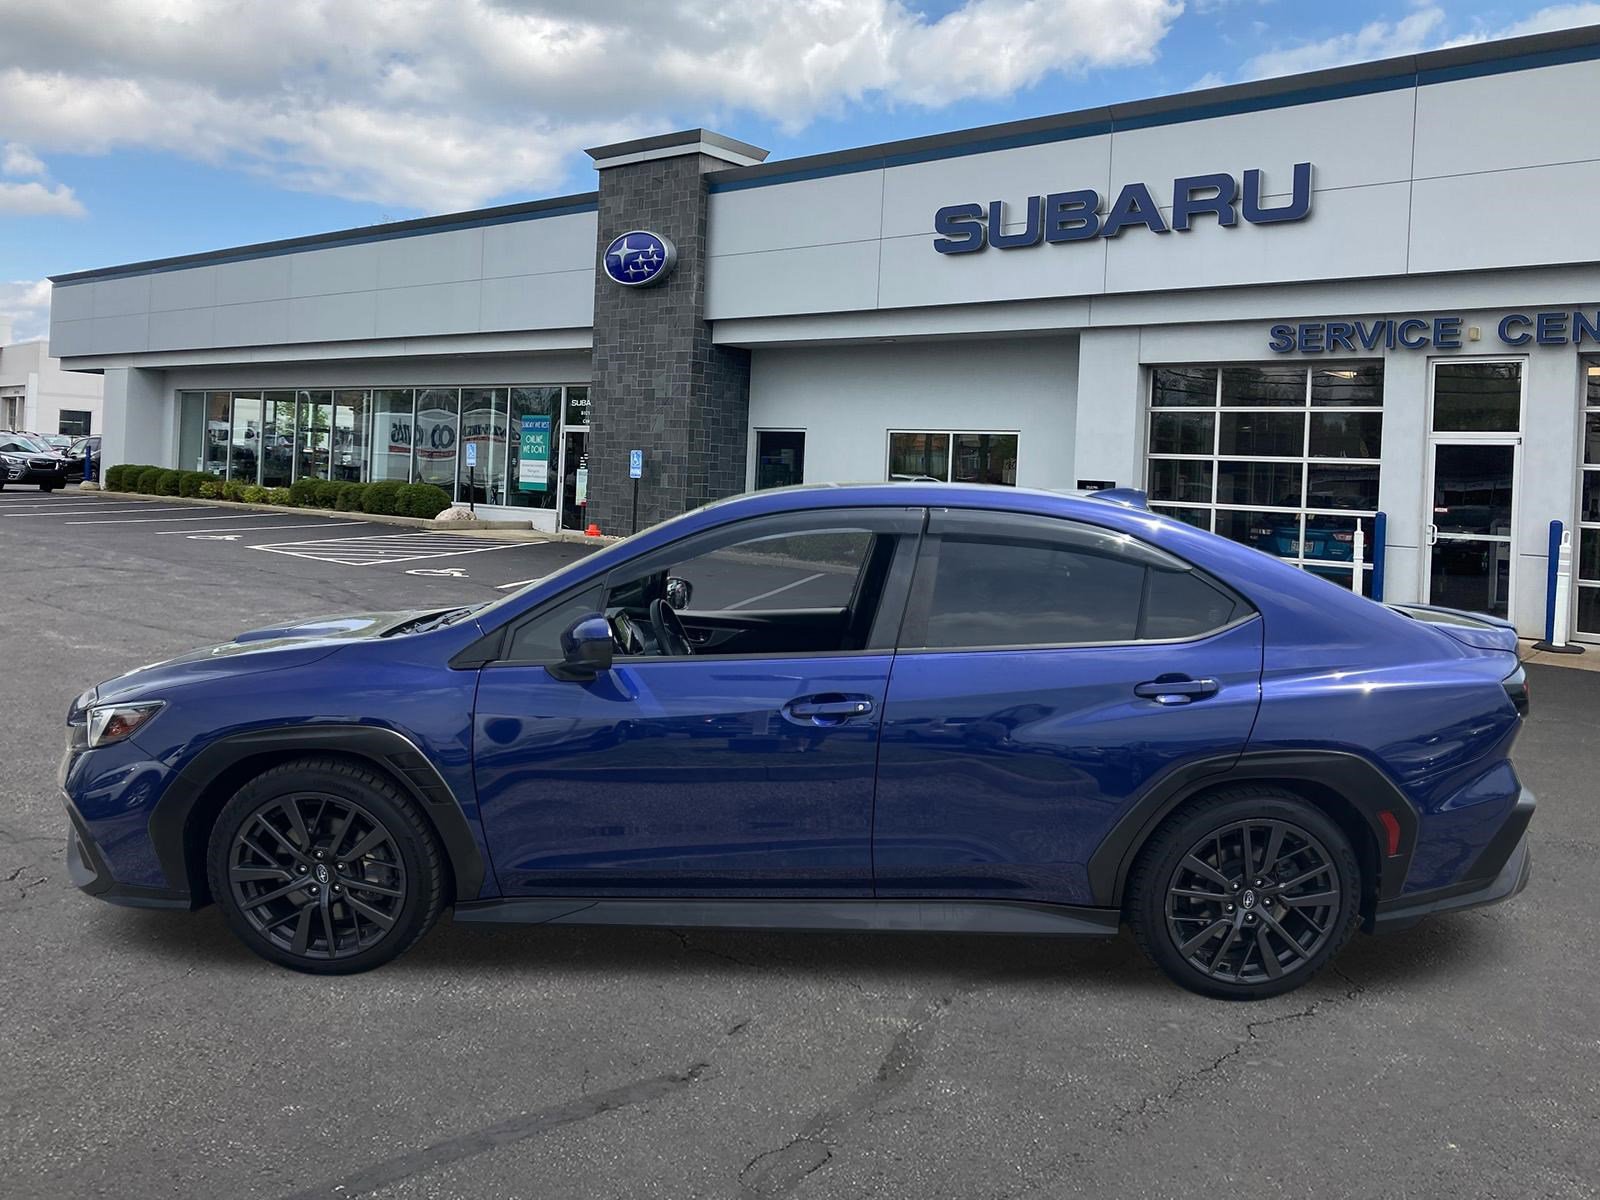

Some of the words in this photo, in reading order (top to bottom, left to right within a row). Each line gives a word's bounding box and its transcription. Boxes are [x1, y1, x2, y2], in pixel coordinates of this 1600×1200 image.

[933, 162, 1312, 255] SUBARU
[1268, 316, 1464, 353] SERVICE
[1497, 311, 1600, 346] CEN
